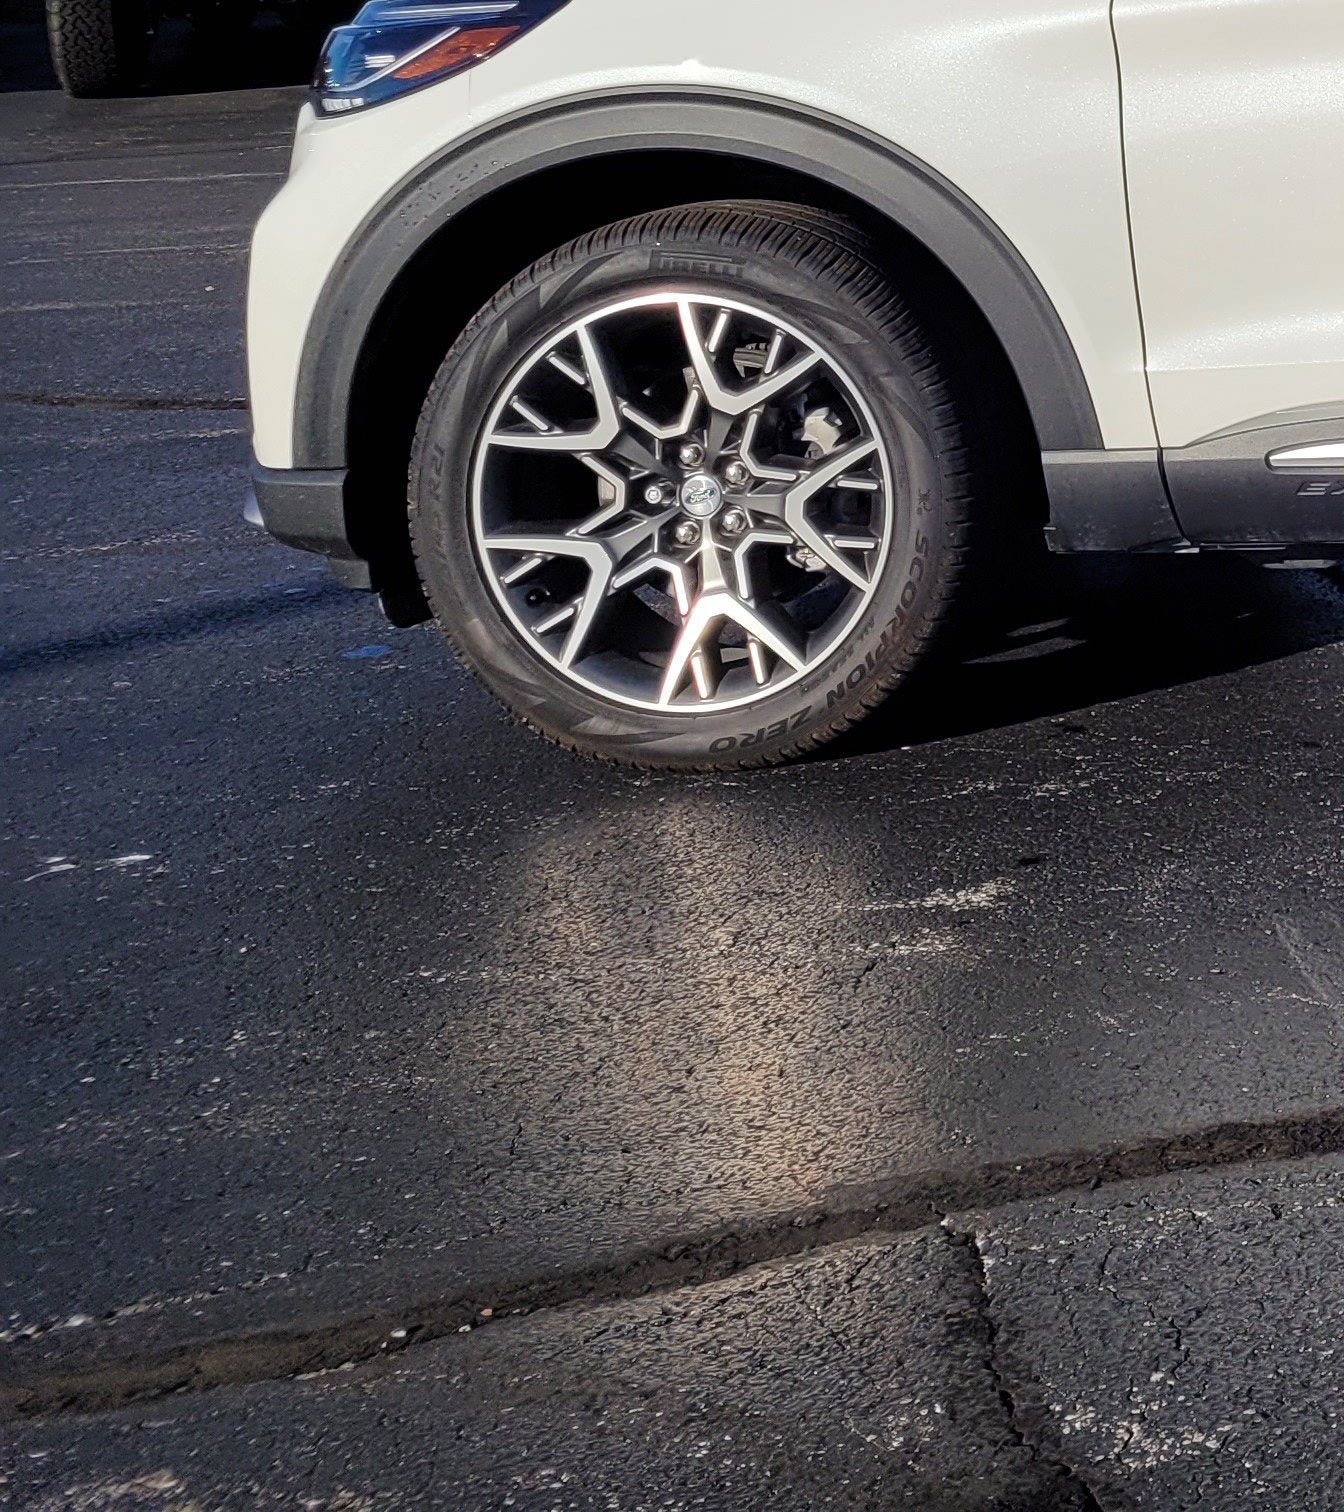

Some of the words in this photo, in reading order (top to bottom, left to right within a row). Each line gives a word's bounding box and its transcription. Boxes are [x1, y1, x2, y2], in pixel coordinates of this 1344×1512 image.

[648, 248, 748, 279] PIRELLI
[826, 529, 929, 710] SCORPION
[709, 704, 812, 753] ZERO
